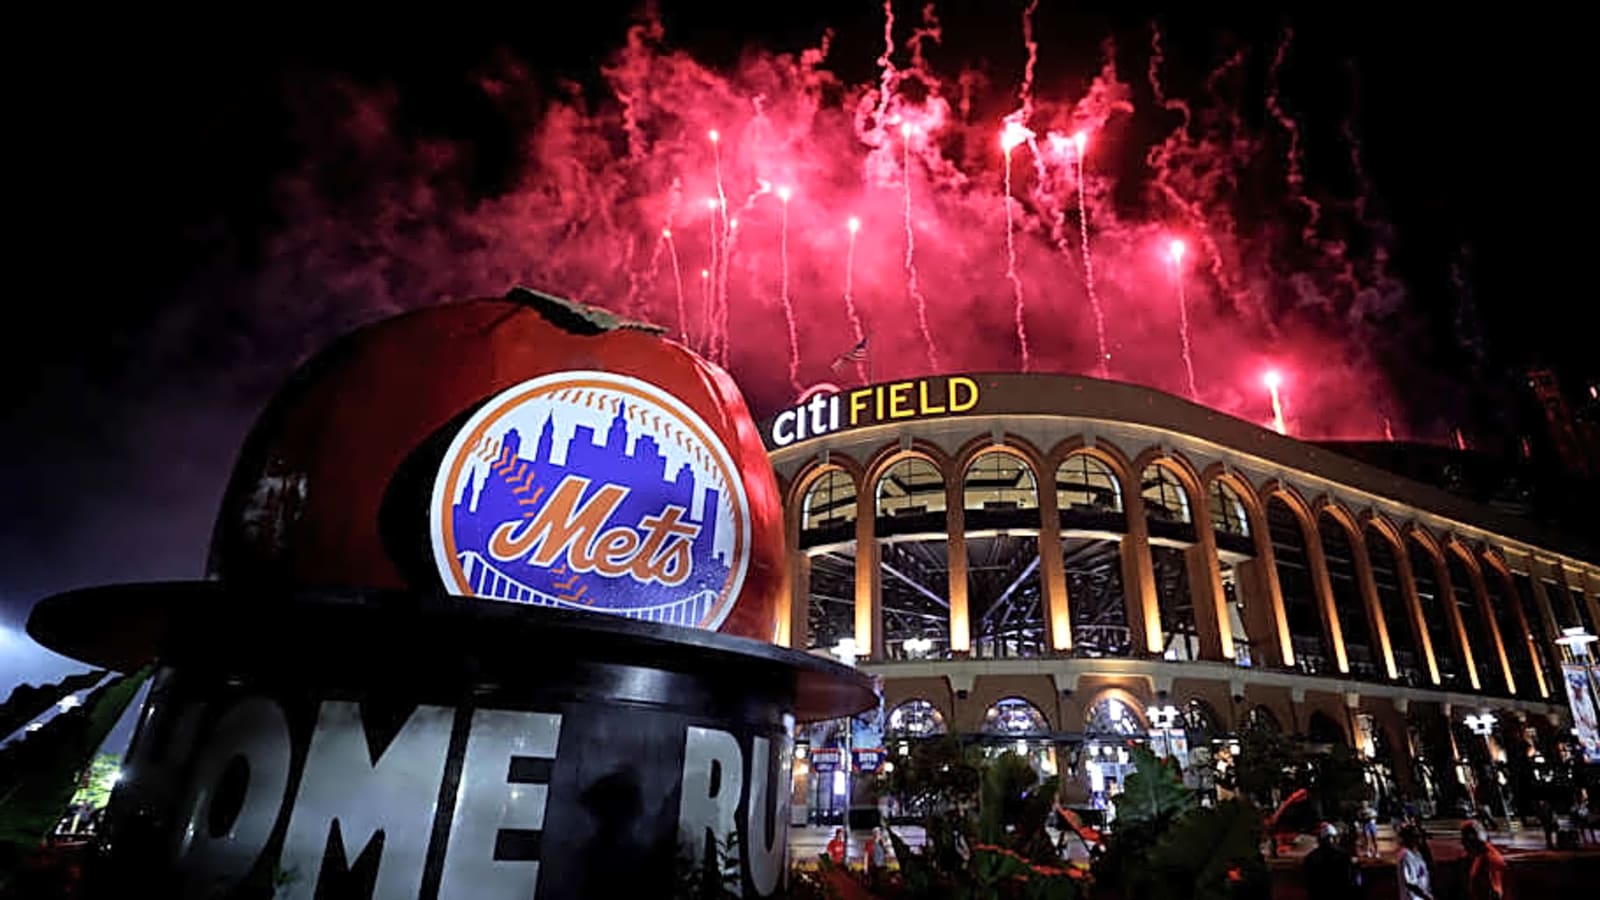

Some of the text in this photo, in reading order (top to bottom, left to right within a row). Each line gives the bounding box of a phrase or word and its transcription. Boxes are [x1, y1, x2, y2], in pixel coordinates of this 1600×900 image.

[772, 376, 979, 446] citi FIELD
[488, 474, 702, 587] Mets
[678, 725, 789, 899] RU
